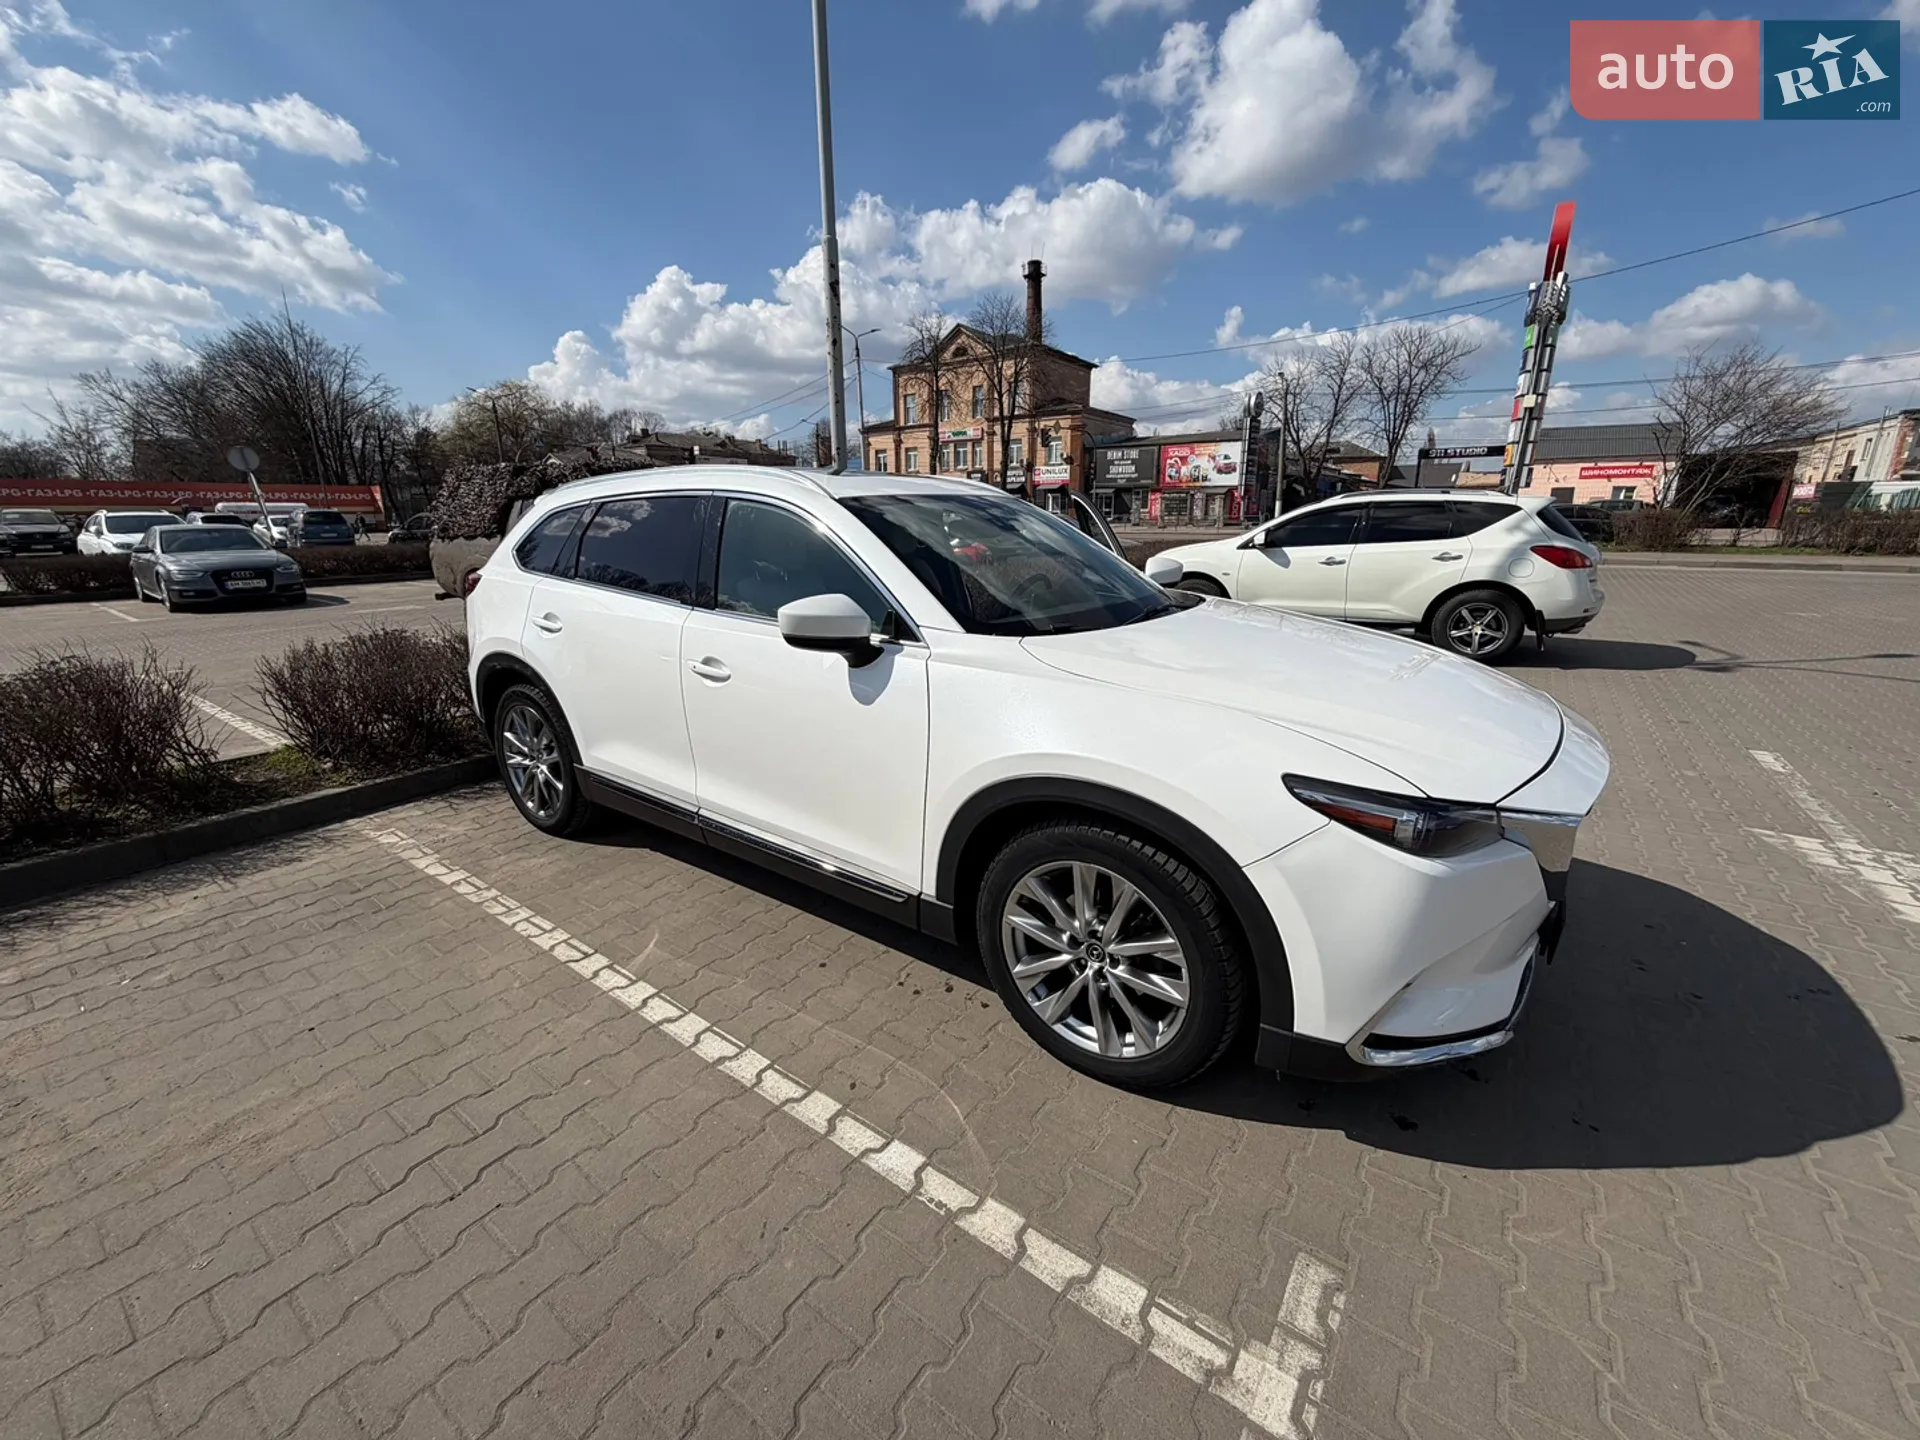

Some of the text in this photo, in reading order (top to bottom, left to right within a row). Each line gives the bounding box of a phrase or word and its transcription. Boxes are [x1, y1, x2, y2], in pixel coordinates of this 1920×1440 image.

[1446, 446, 1489, 457] STUDIO
[1041, 467, 1069, 476] UNILUX
[1581, 467, 1652, 477] ШИНОМОНТАЖ
